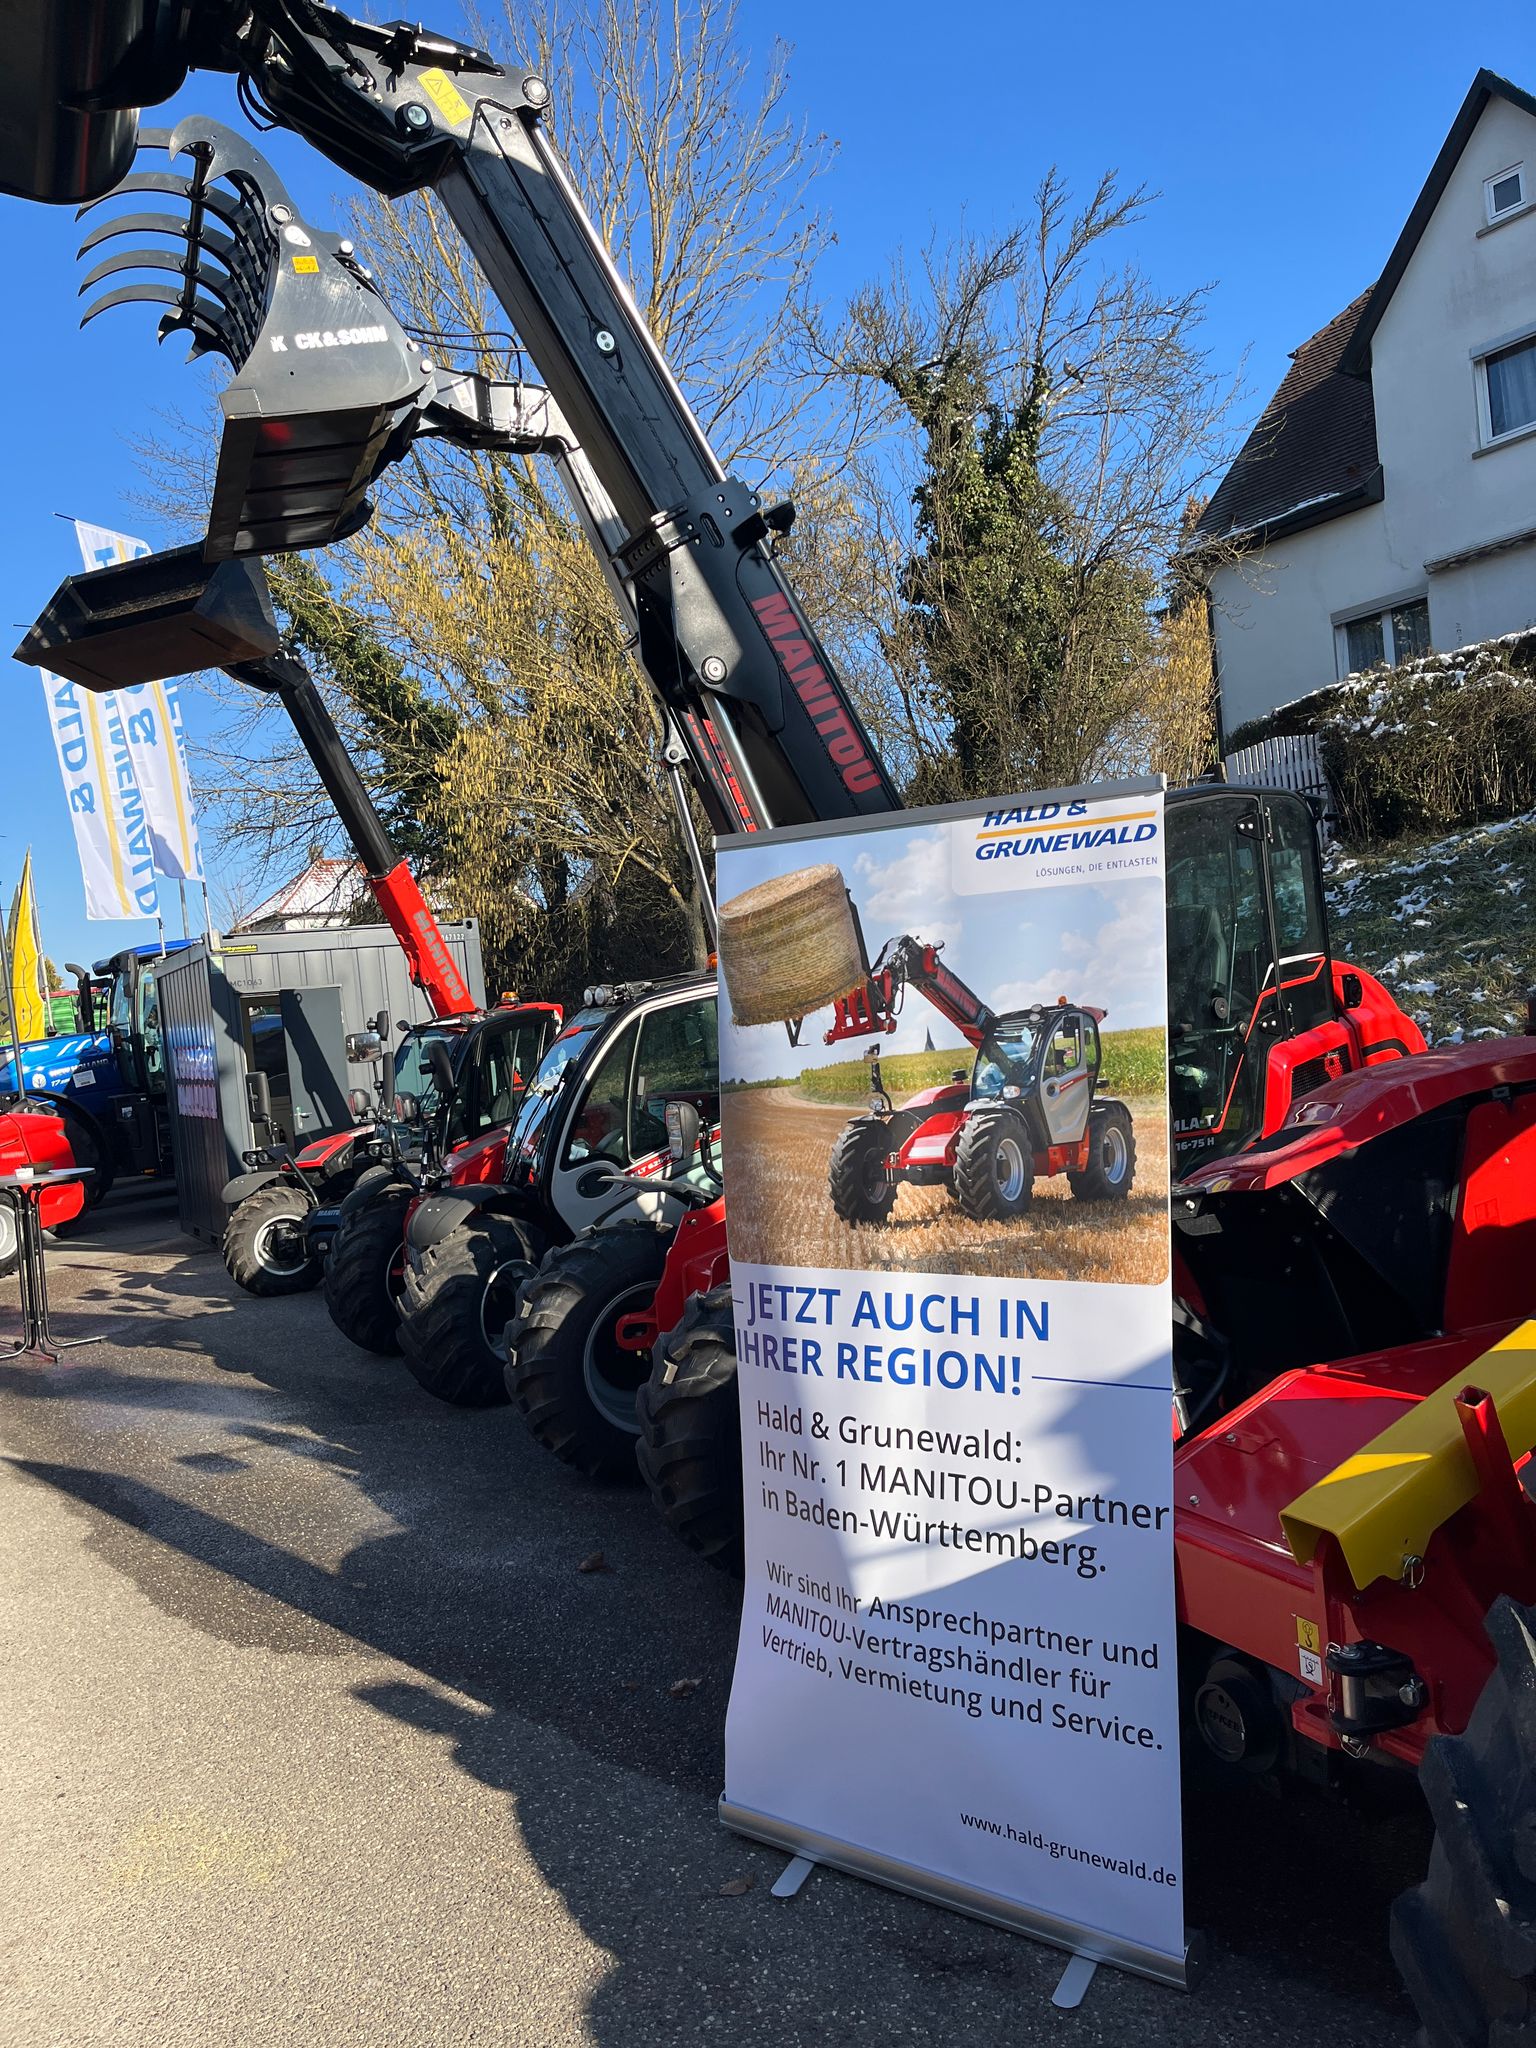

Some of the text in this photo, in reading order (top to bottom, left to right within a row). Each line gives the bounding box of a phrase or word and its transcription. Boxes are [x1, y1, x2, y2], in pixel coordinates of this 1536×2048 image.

[751, 592, 882, 794] MANITOU
[976, 823, 1158, 860] GRUNEWALD
[983, 799, 1088, 828] HALD &
[1036, 856, 1158, 878] LÖSUNGEN, DIE ENTLASTEN
[412, 911, 465, 1001] MANITOU
[1207, 1136, 1215, 1146] H
[747, 1282, 1049, 1341] JETZT AUCH IN
[737, 1328, 1021, 1395] IHRER REGION!
[758, 1400, 1022, 1463] Hald & Grunewald:
[760, 1441, 1170, 1530] Ihr Nr. 1 MANITOU-Partner
[762, 1482, 1106, 1579] in Baden-Württemberg.
[766, 1560, 1158, 1669] Wir sind Ihr Ansprechpartner und
[766, 1593, 1111, 1699] MANITOU-Vertragshändler für
[763, 1625, 1163, 1750] Vertrieb, Vermietung und Service.
[960, 1813, 1177, 1887] www.hald-grunewald.de
